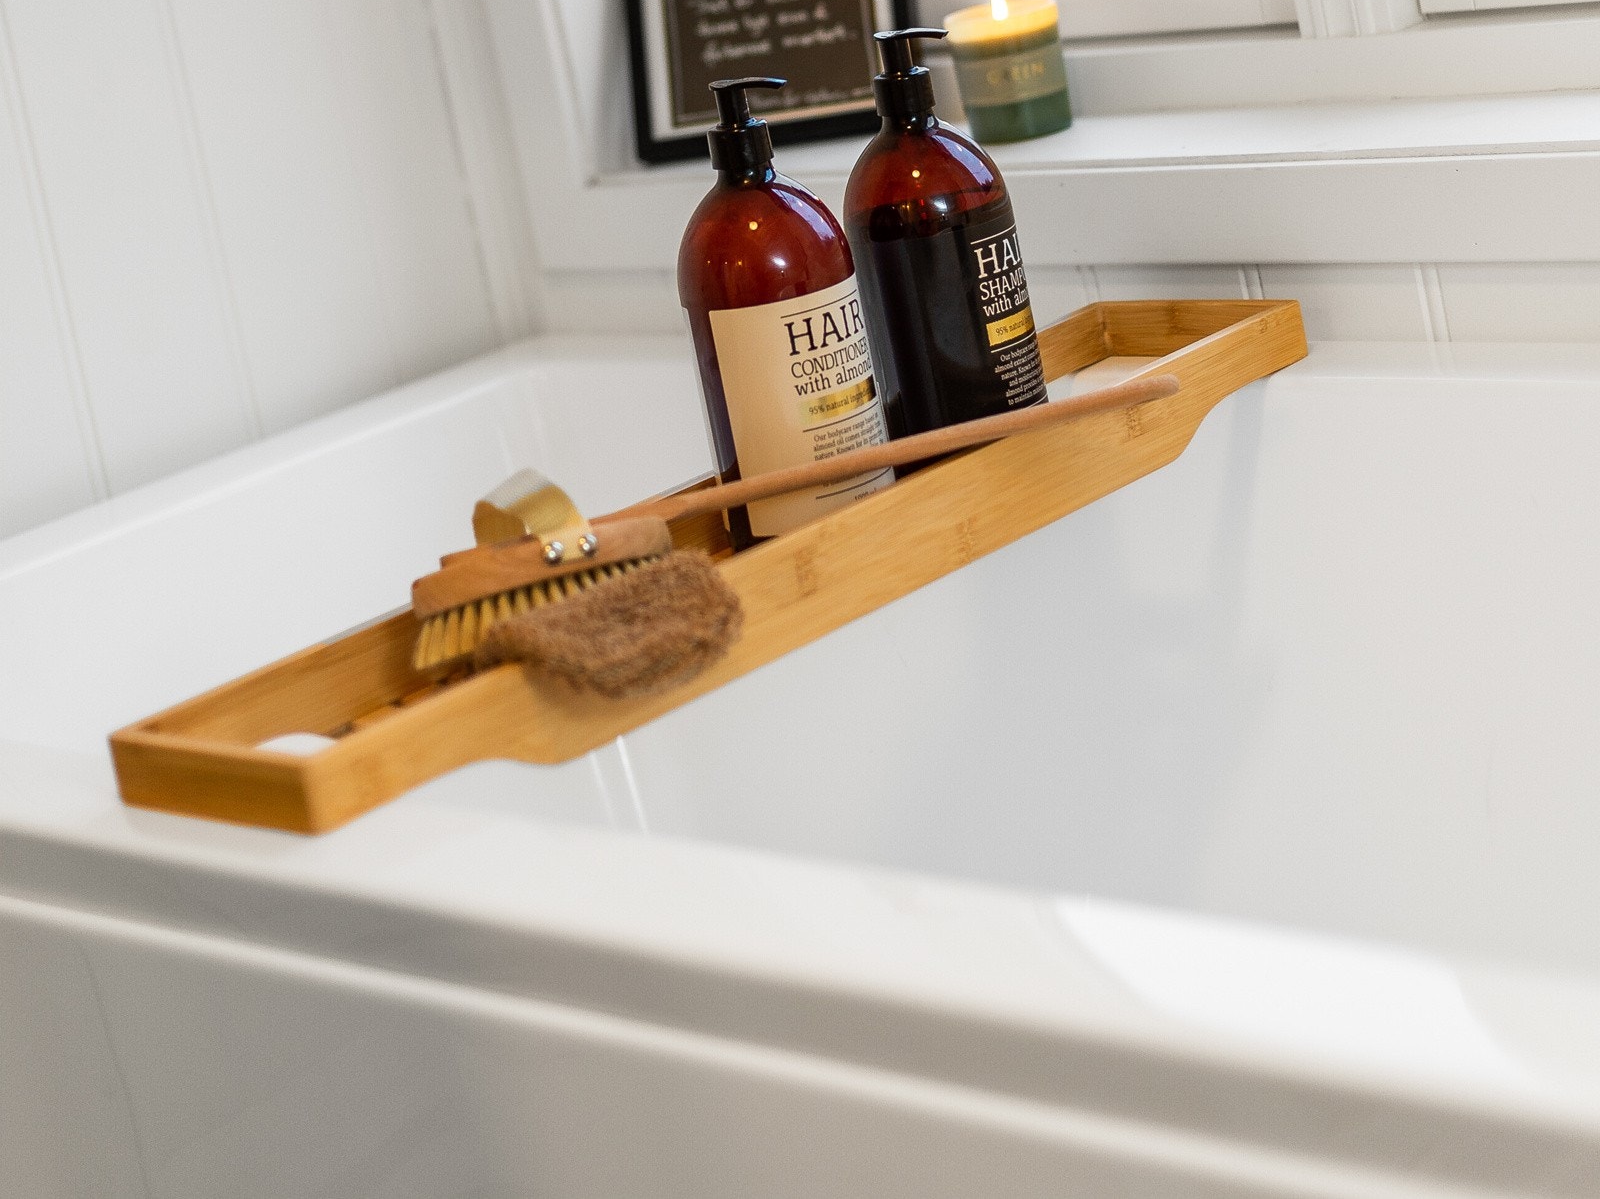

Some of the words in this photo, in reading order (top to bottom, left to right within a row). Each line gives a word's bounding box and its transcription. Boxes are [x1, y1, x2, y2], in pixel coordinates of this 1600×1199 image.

[974, 232, 1021, 278] HAI
[983, 294, 1012, 317] with
[784, 299, 864, 357] HAIR
[995, 325, 1009, 337] 95%
[791, 335, 869, 379] CONDITIONER
[1000, 354, 1011, 362] Our
[795, 373, 831, 396] with
[835, 353, 872, 385] almond
[995, 361, 1013, 373] almond
[1006, 384, 1023, 397] almond
[1009, 377, 1019, 387] and
[808, 404, 825, 416] 95%
[826, 396, 849, 411] natural
[813, 433, 826, 442] Our
[827, 425, 852, 440] bodycare
[813, 441, 836, 452] almond
[836, 436, 845, 445] oil
[845, 432, 860, 443] comes
[836, 444, 856, 455] Known
